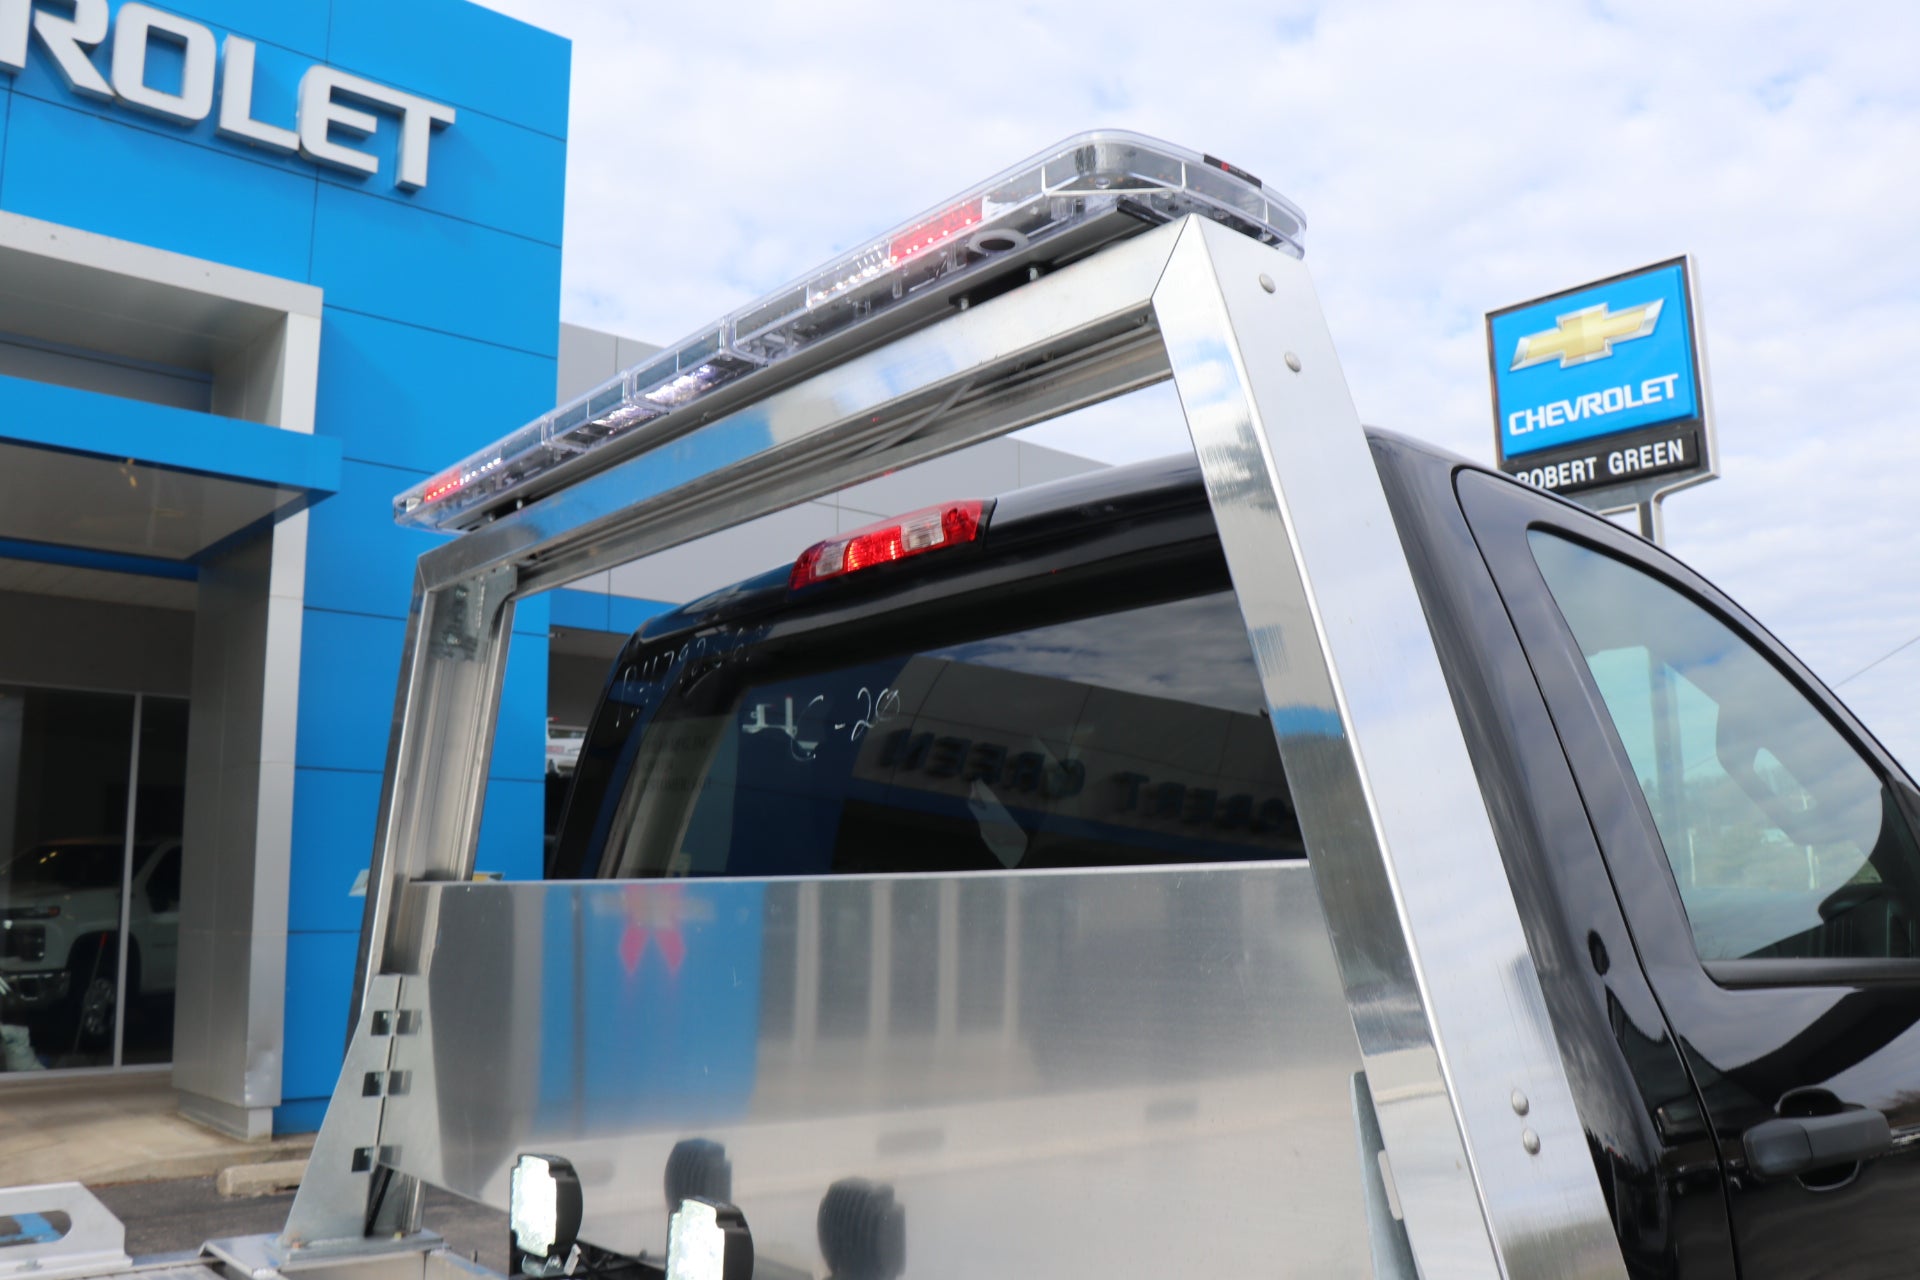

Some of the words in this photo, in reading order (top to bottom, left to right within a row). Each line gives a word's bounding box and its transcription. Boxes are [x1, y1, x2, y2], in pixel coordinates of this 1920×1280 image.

[0, 0, 456, 190] ROLET
[1508, 373, 1679, 436] CHEVROLET
[1608, 438, 1684, 475] GREEN
